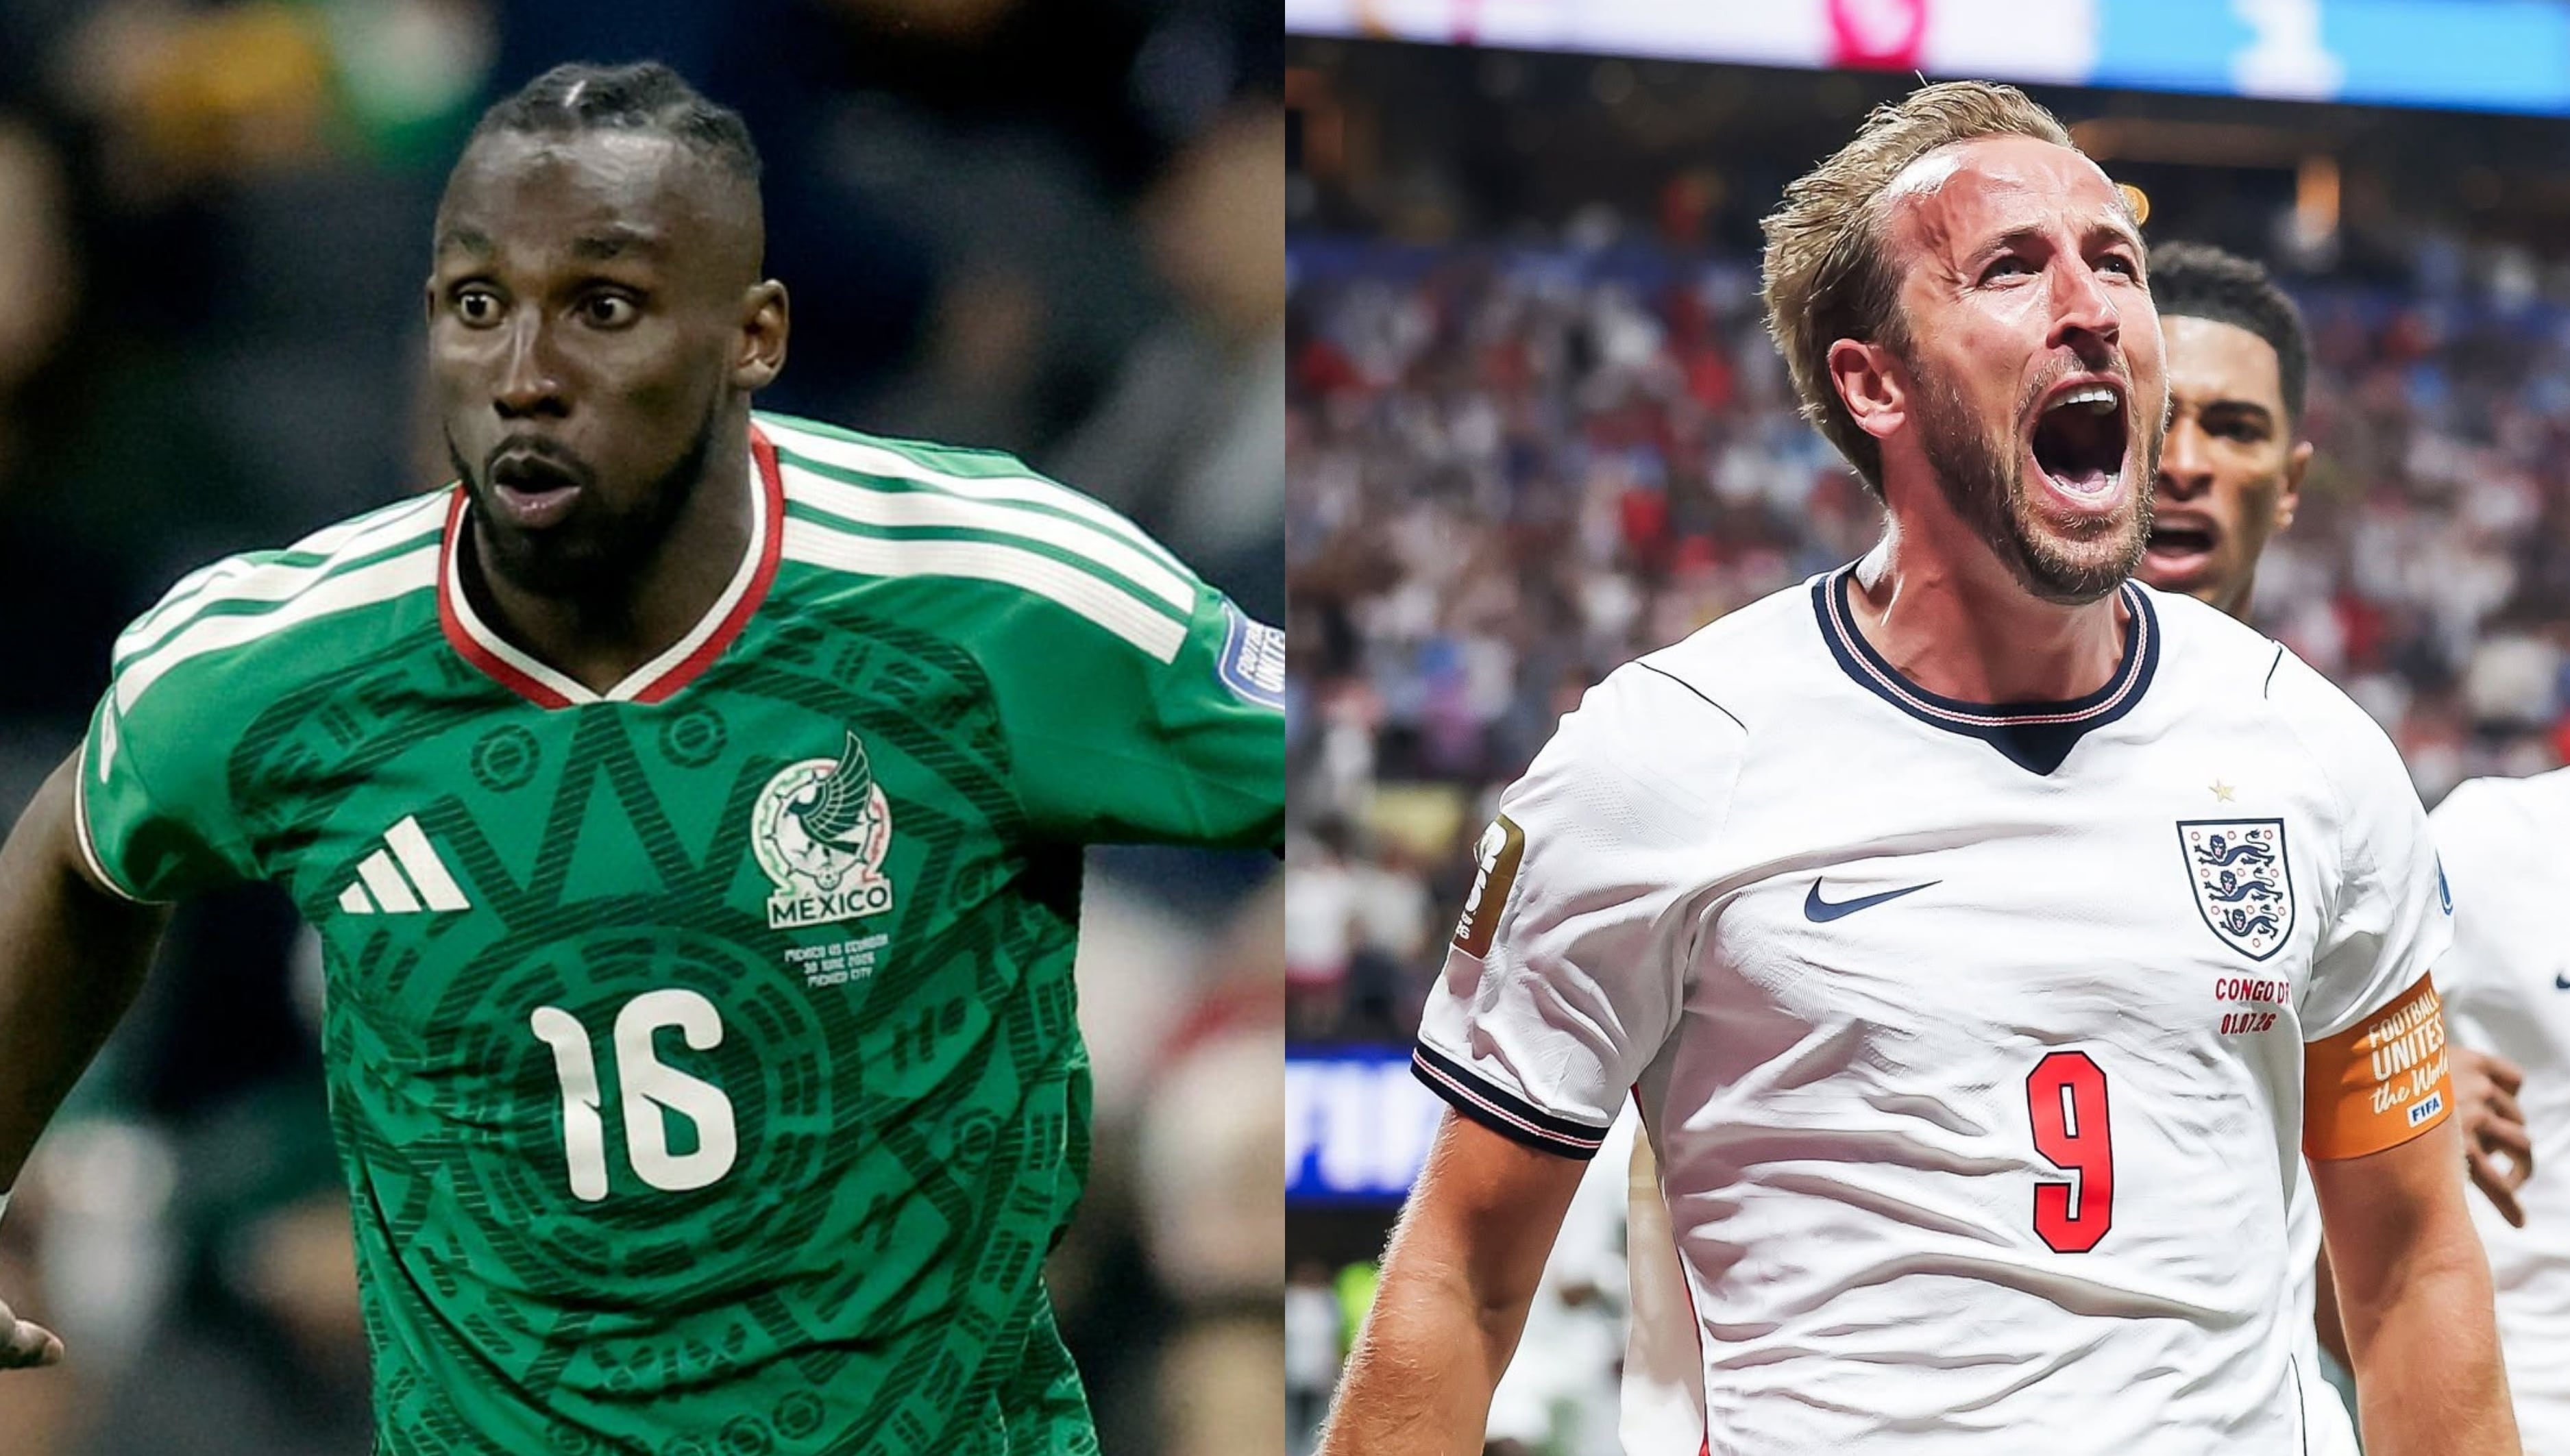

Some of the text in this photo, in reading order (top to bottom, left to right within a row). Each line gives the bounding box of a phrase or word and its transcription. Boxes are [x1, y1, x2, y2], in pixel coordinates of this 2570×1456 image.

[772, 887, 888, 924] MÉXICO
[2215, 978, 2274, 1002] CONGO
[2369, 987, 2440, 1048] FOOTBALL
[2372, 1013, 2445, 1081] UNITES
[530, 988, 737, 1202] 16
[2369, 1081, 2410, 1115] the
[2412, 1097, 2440, 1123] FIFA
[2025, 1050, 2114, 1254] 9
